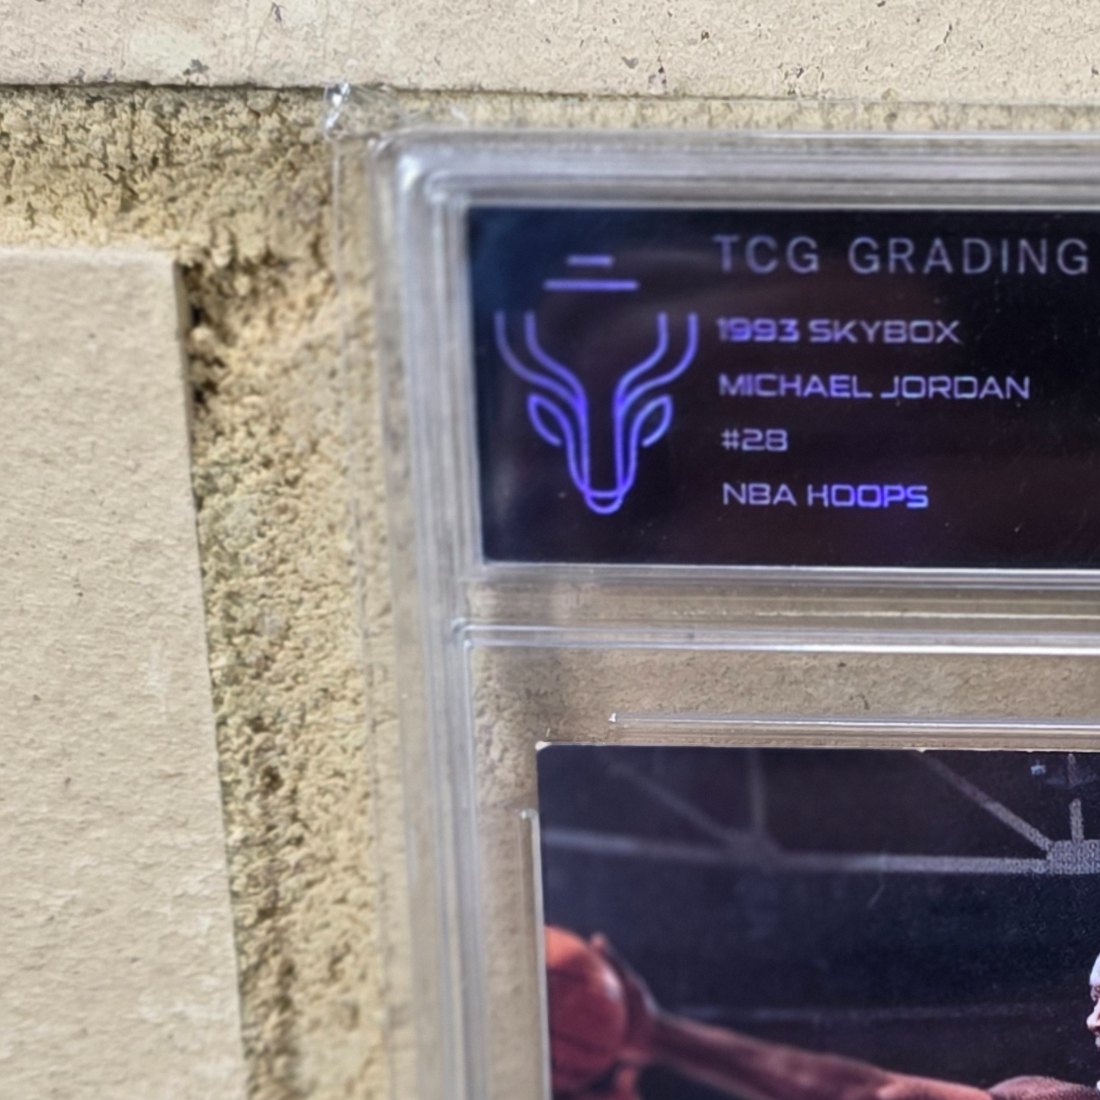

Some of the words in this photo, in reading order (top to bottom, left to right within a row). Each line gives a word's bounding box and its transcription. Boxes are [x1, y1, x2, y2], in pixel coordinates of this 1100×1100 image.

[714, 234, 820, 273] TCG
[848, 237, 1089, 275] GRADING
[718, 318, 800, 343] 1993
[808, 320, 961, 345] SKYBOX
[719, 374, 872, 400] MICHAEL
[880, 376, 1031, 400] JORDAN
[721, 429, 789, 452] #28
[722, 482, 797, 506] NBA
[807, 484, 929, 508] HOOPS
